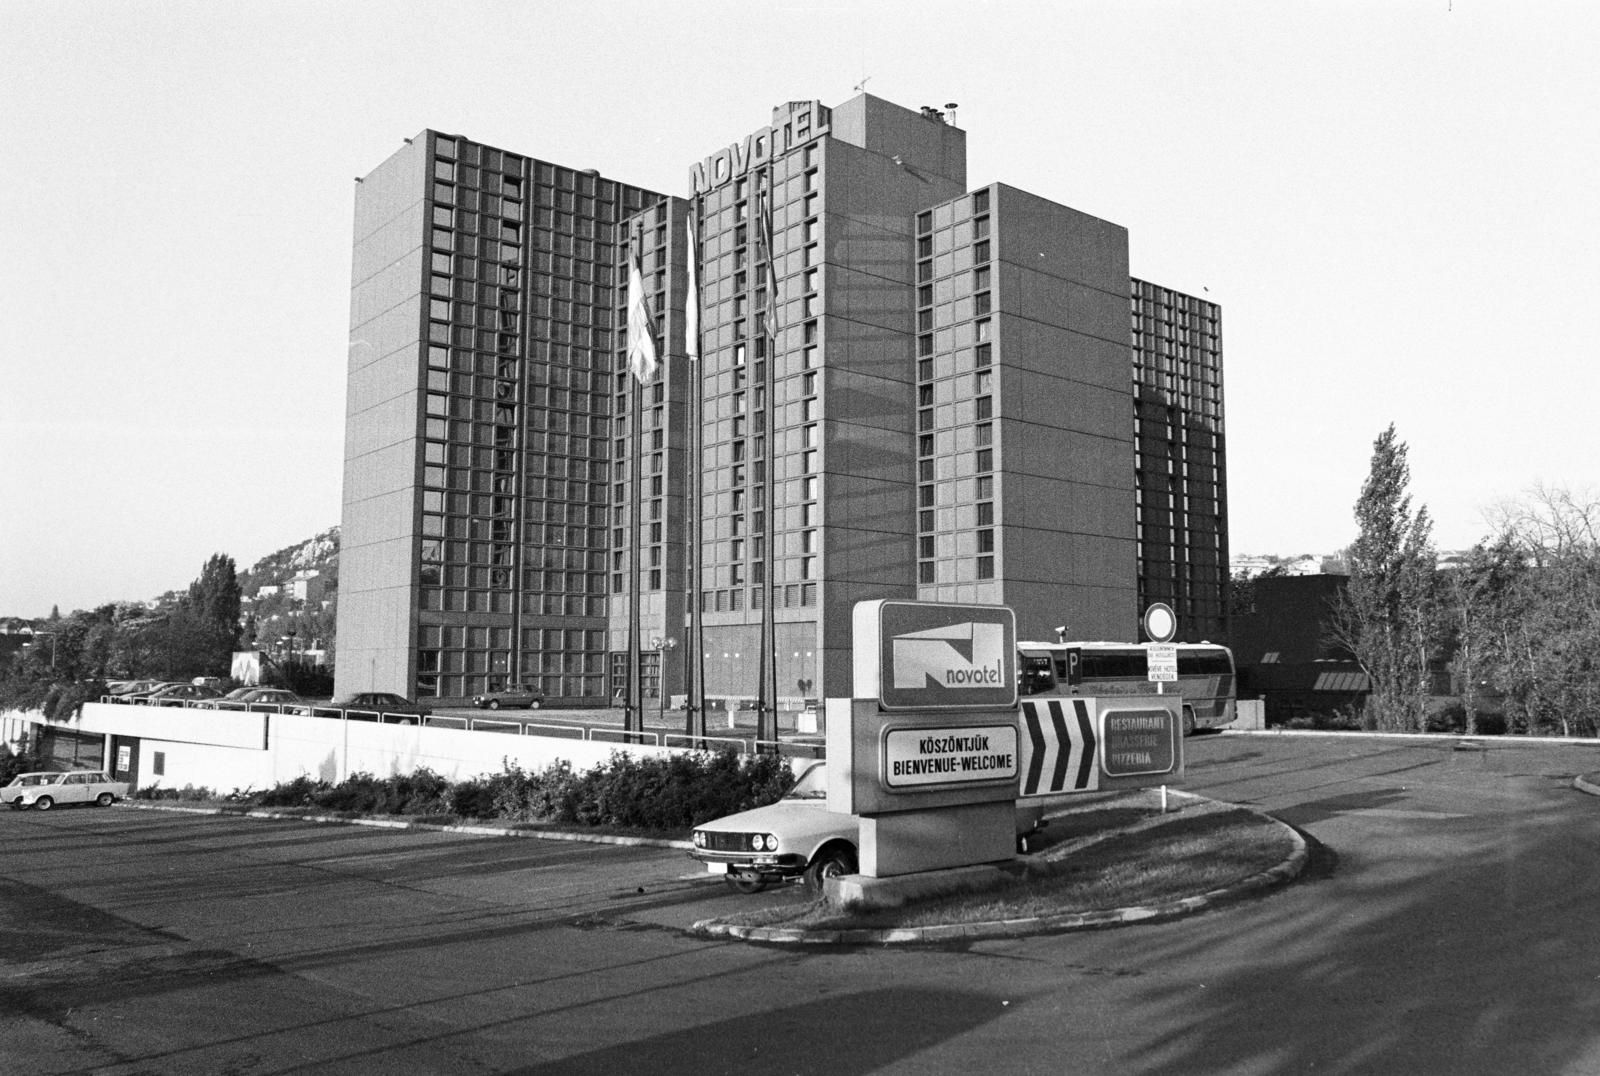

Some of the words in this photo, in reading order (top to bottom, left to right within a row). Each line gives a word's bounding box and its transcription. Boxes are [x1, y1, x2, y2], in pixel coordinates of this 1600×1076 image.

[689, 99, 829, 200] NOVOTEL
[946, 659, 1002, 684] novotel
[1069, 652, 1078, 675] P
[1110, 717, 1165, 732] RESTAURANT
[919, 734, 989, 754] KÖSZÖNTJÜK
[893, 754, 1013, 776] BIENVENUE-WELCOME
[1111, 751, 1152, 766] PIZZERIA
